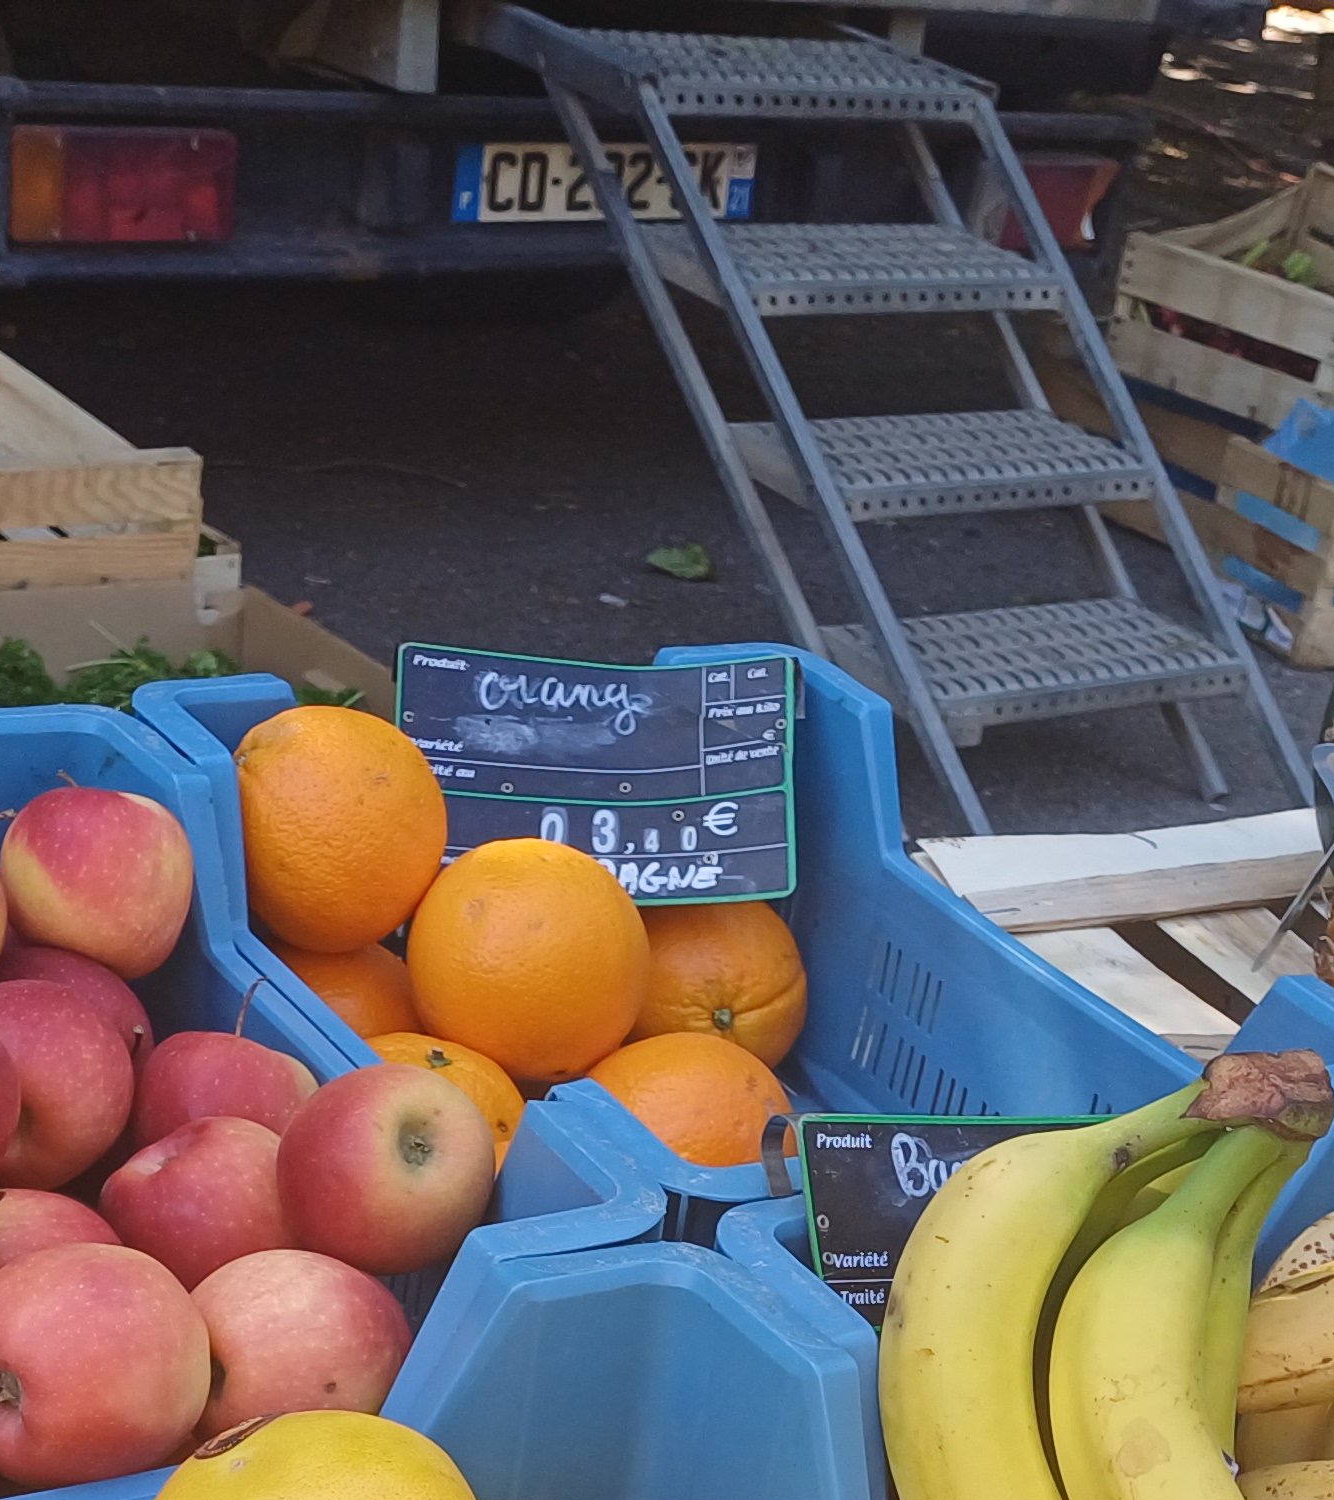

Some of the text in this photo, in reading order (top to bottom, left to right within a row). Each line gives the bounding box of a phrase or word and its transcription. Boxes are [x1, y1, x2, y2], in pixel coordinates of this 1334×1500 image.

[413, 654, 468, 672] Produit
[702, 801, 739, 836] €
[817, 1133, 873, 1150] Produit
[833, 1250, 889, 1269] Variété
[840, 1287, 886, 1306] Traité
